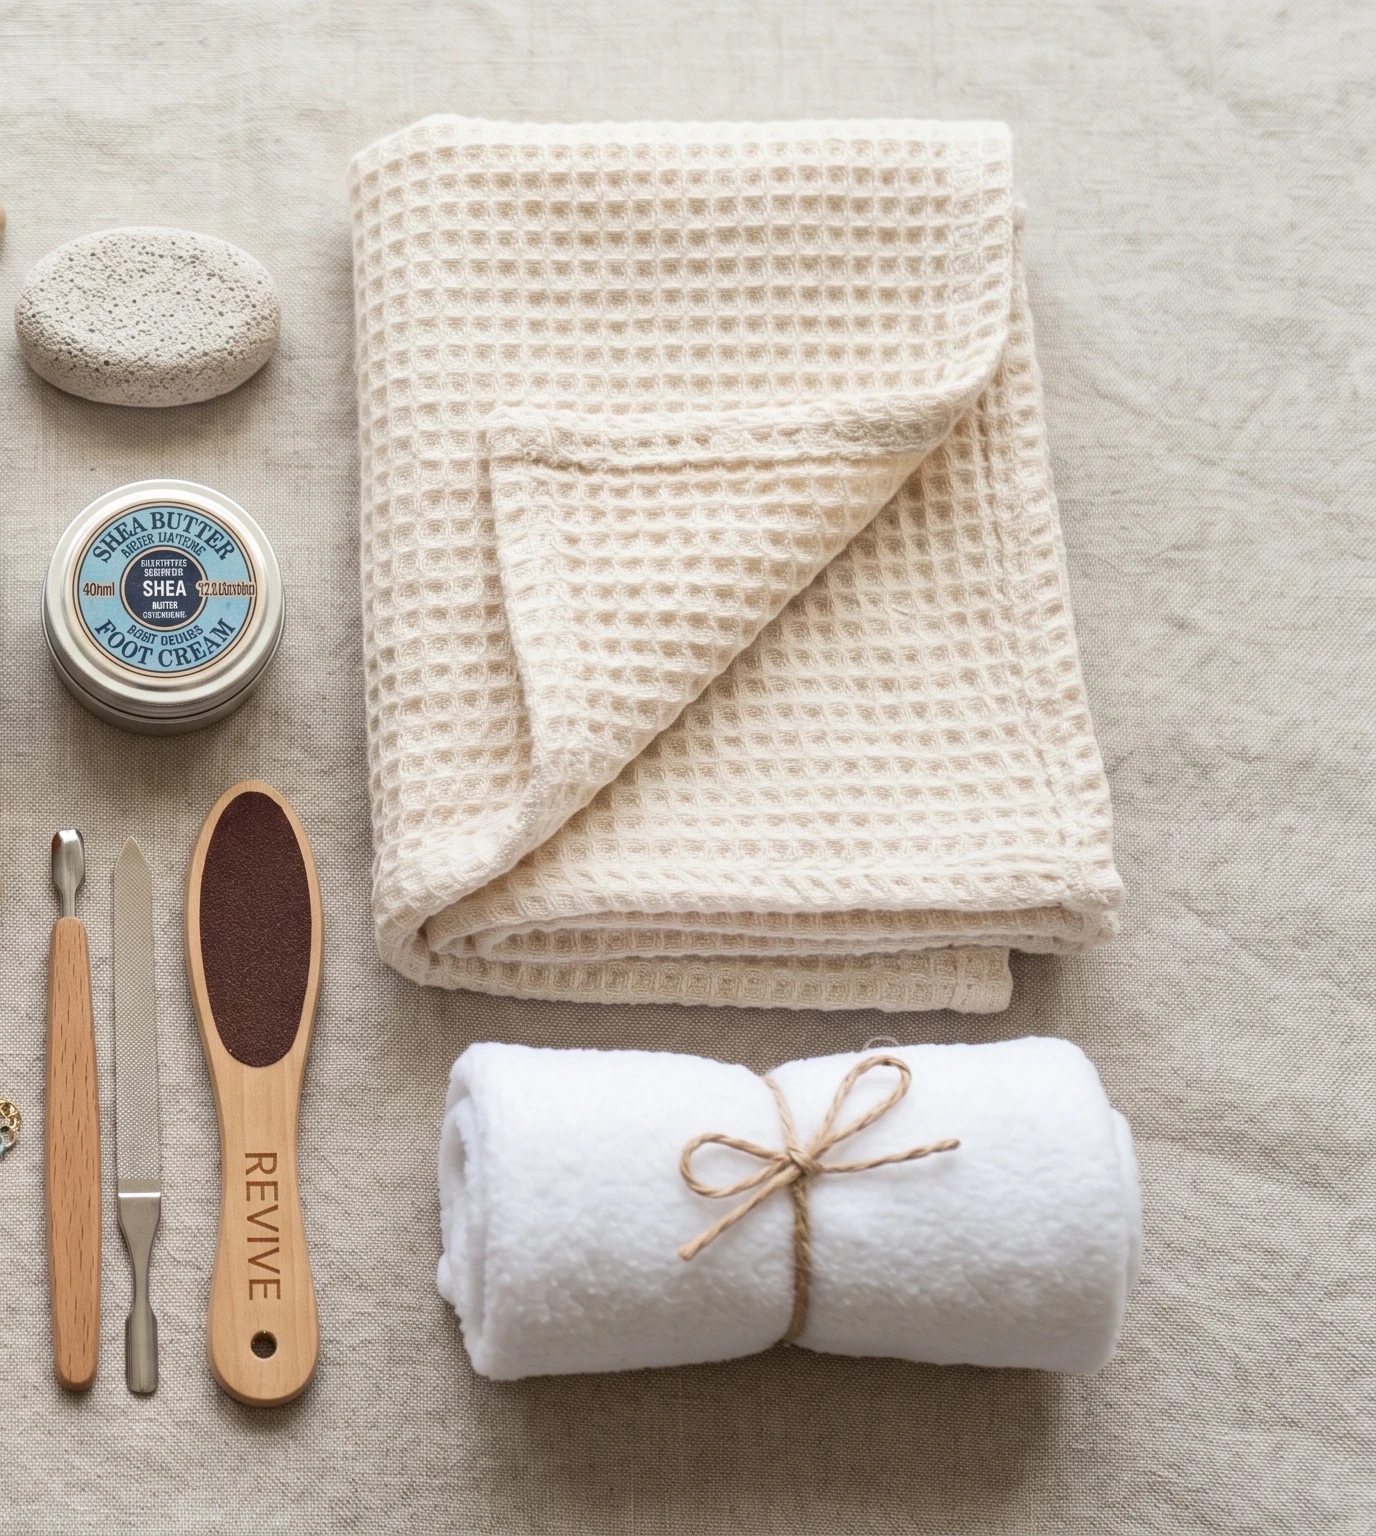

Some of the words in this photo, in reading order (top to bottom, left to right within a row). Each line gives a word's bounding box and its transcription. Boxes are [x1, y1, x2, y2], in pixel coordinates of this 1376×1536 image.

[92, 516, 148, 563] SHEA
[149, 511, 236, 560] BUTTER
[142, 579, 187, 597] SHEA
[94, 618, 154, 666] FOOT
[157, 617, 236, 668] CREAM
[244, 1152, 281, 1301] REVIVE
